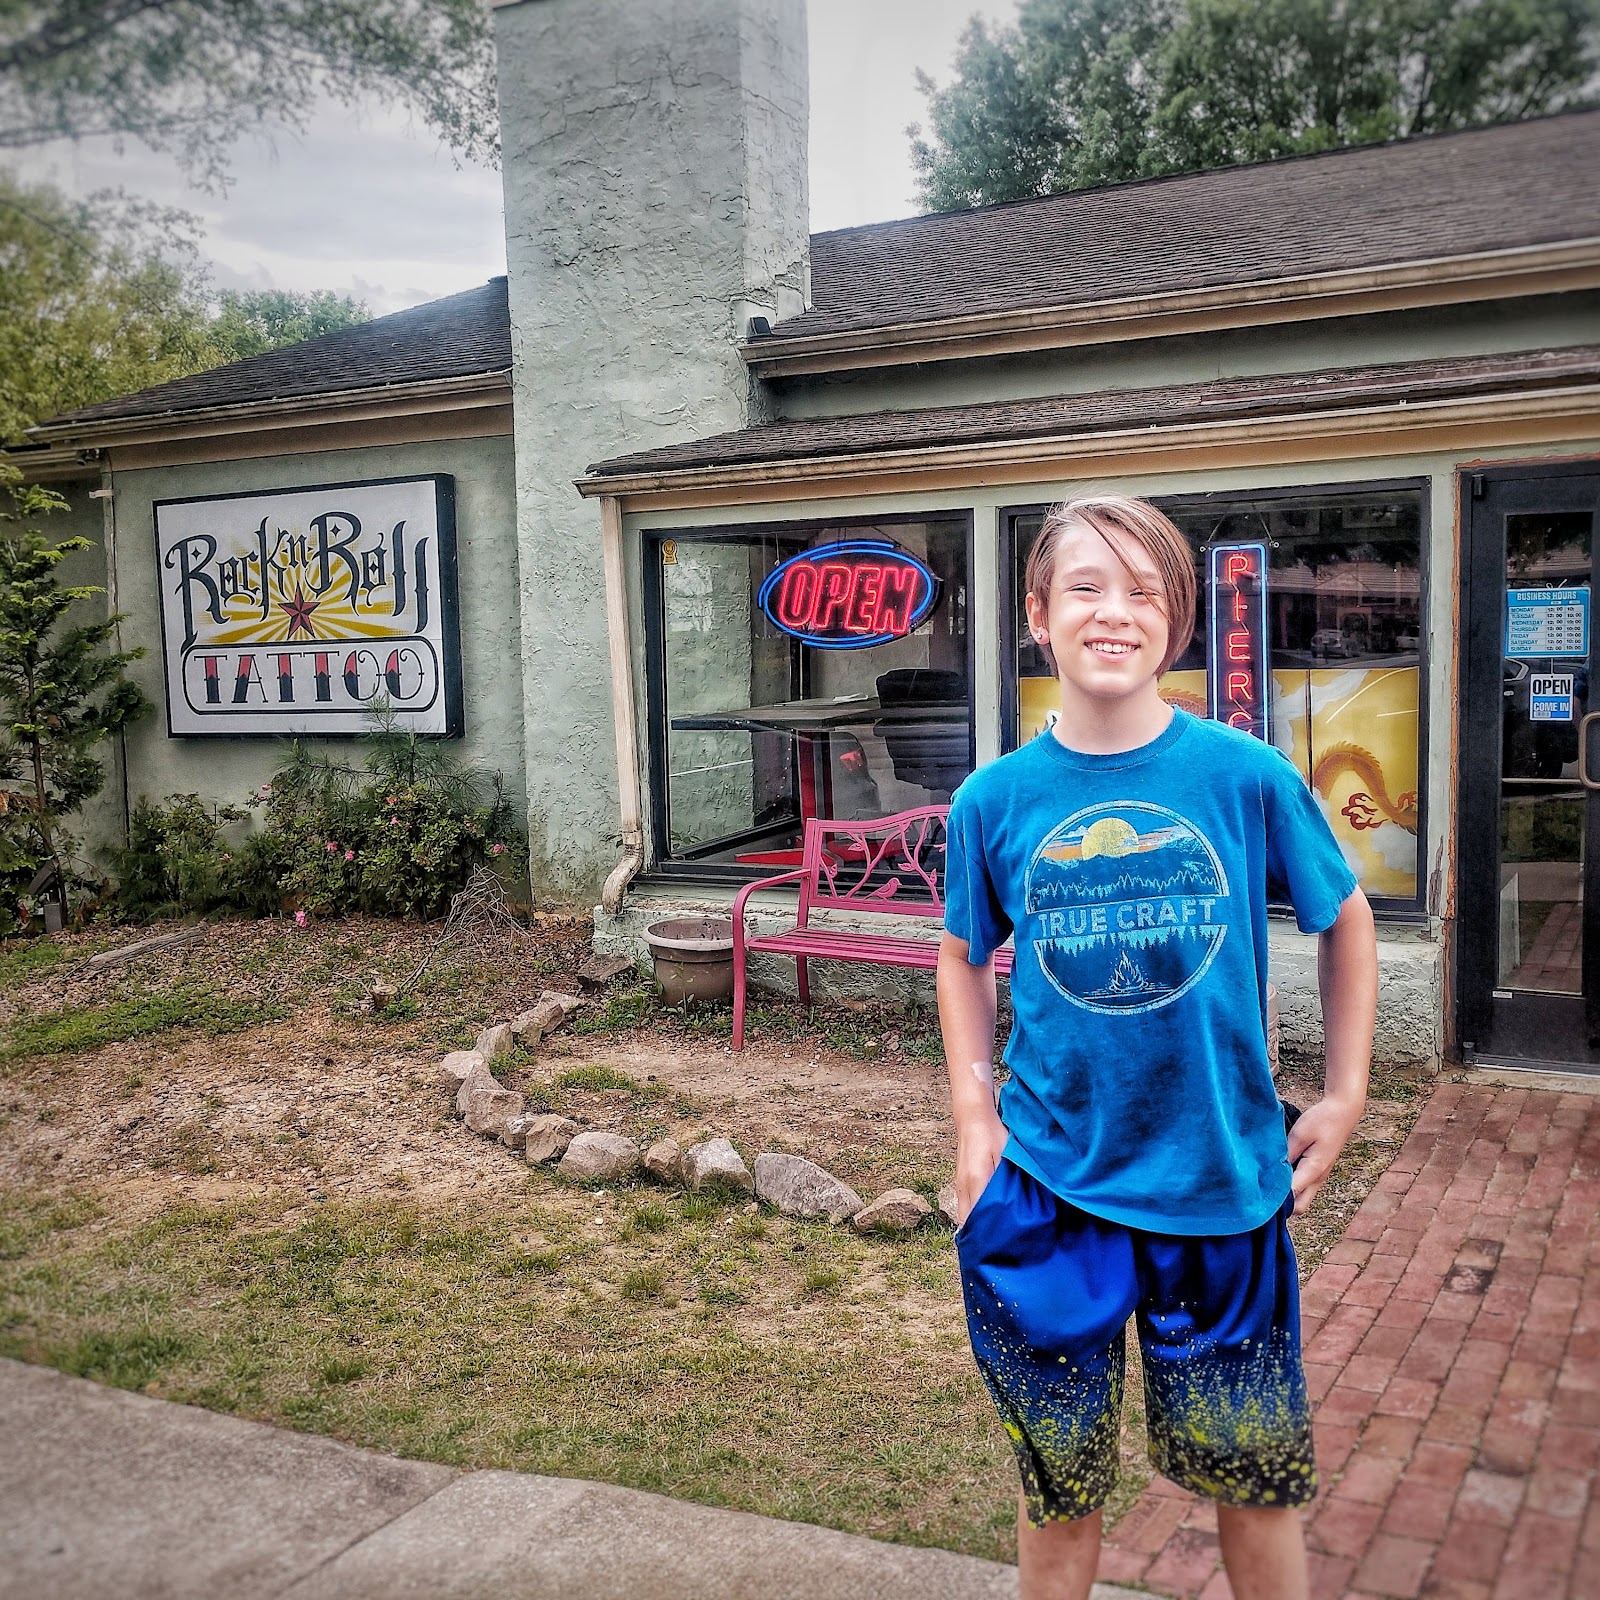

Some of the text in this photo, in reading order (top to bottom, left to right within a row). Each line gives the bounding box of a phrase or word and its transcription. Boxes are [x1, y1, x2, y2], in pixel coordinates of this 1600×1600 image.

[164, 516, 289, 656] Rock
[304, 511, 430, 633] Roll
[778, 561, 919, 634] OPEN
[1517, 591, 1577, 600] BUSINESS HOURS
[193, 648, 425, 704] TATTOO
[1532, 679, 1570, 694] OPEN
[1534, 702, 1569, 712] COME IN
[1038, 898, 1216, 937] TRUE CRAFT
